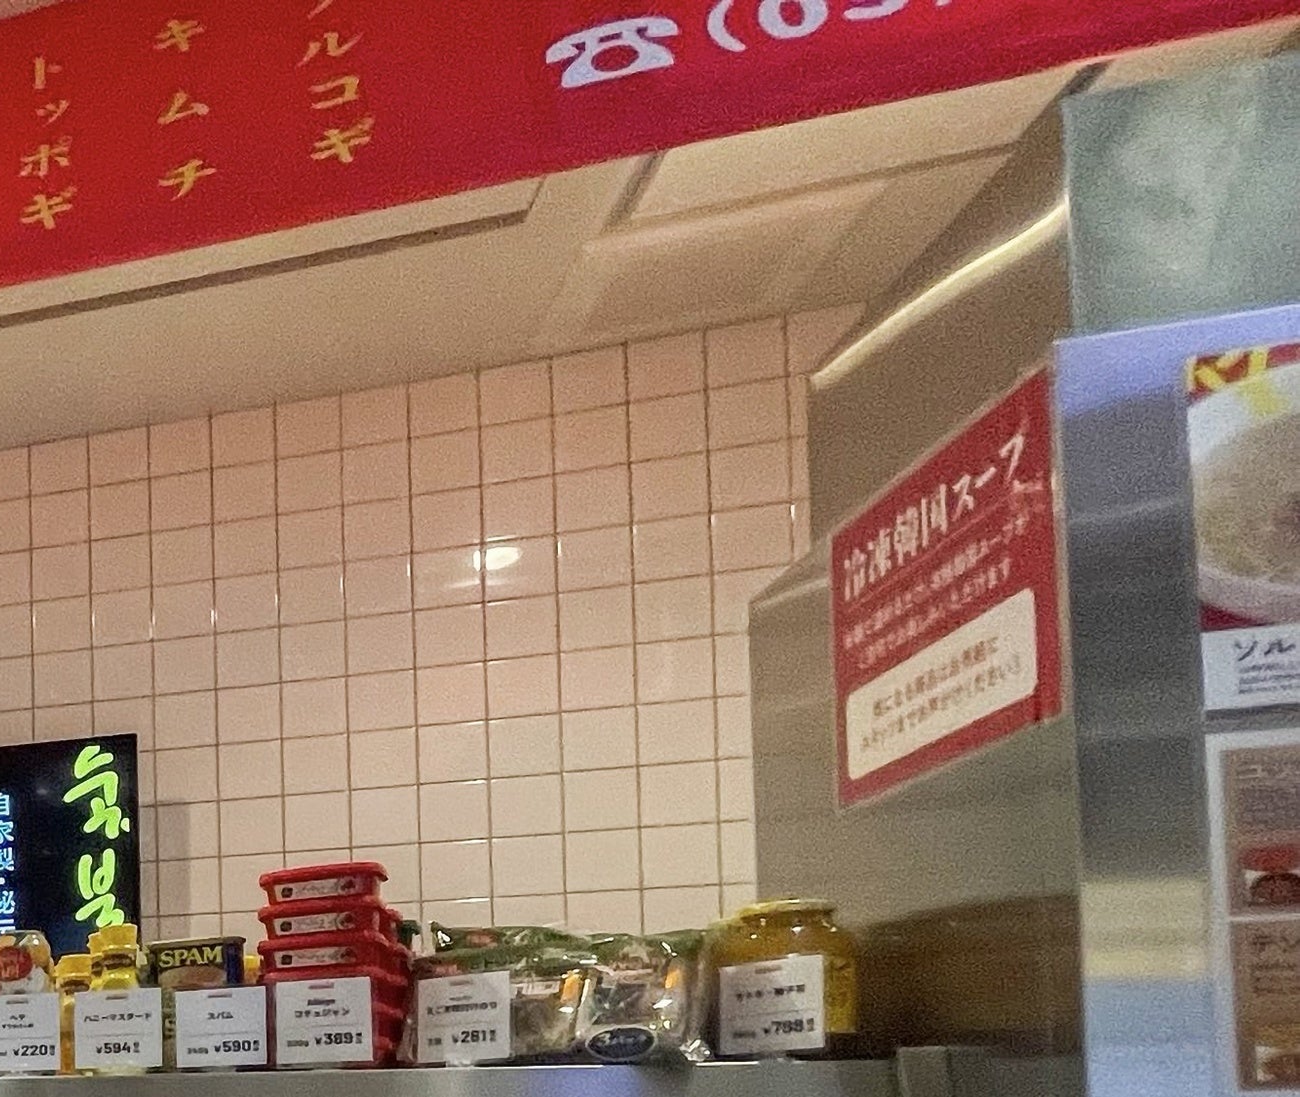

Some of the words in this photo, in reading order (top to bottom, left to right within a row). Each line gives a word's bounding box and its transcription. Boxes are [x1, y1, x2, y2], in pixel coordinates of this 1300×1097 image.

[19, 56, 79, 230] トッポギ
[154, 19, 217, 201] キムチ
[158, 946, 224, 968] SPAM
